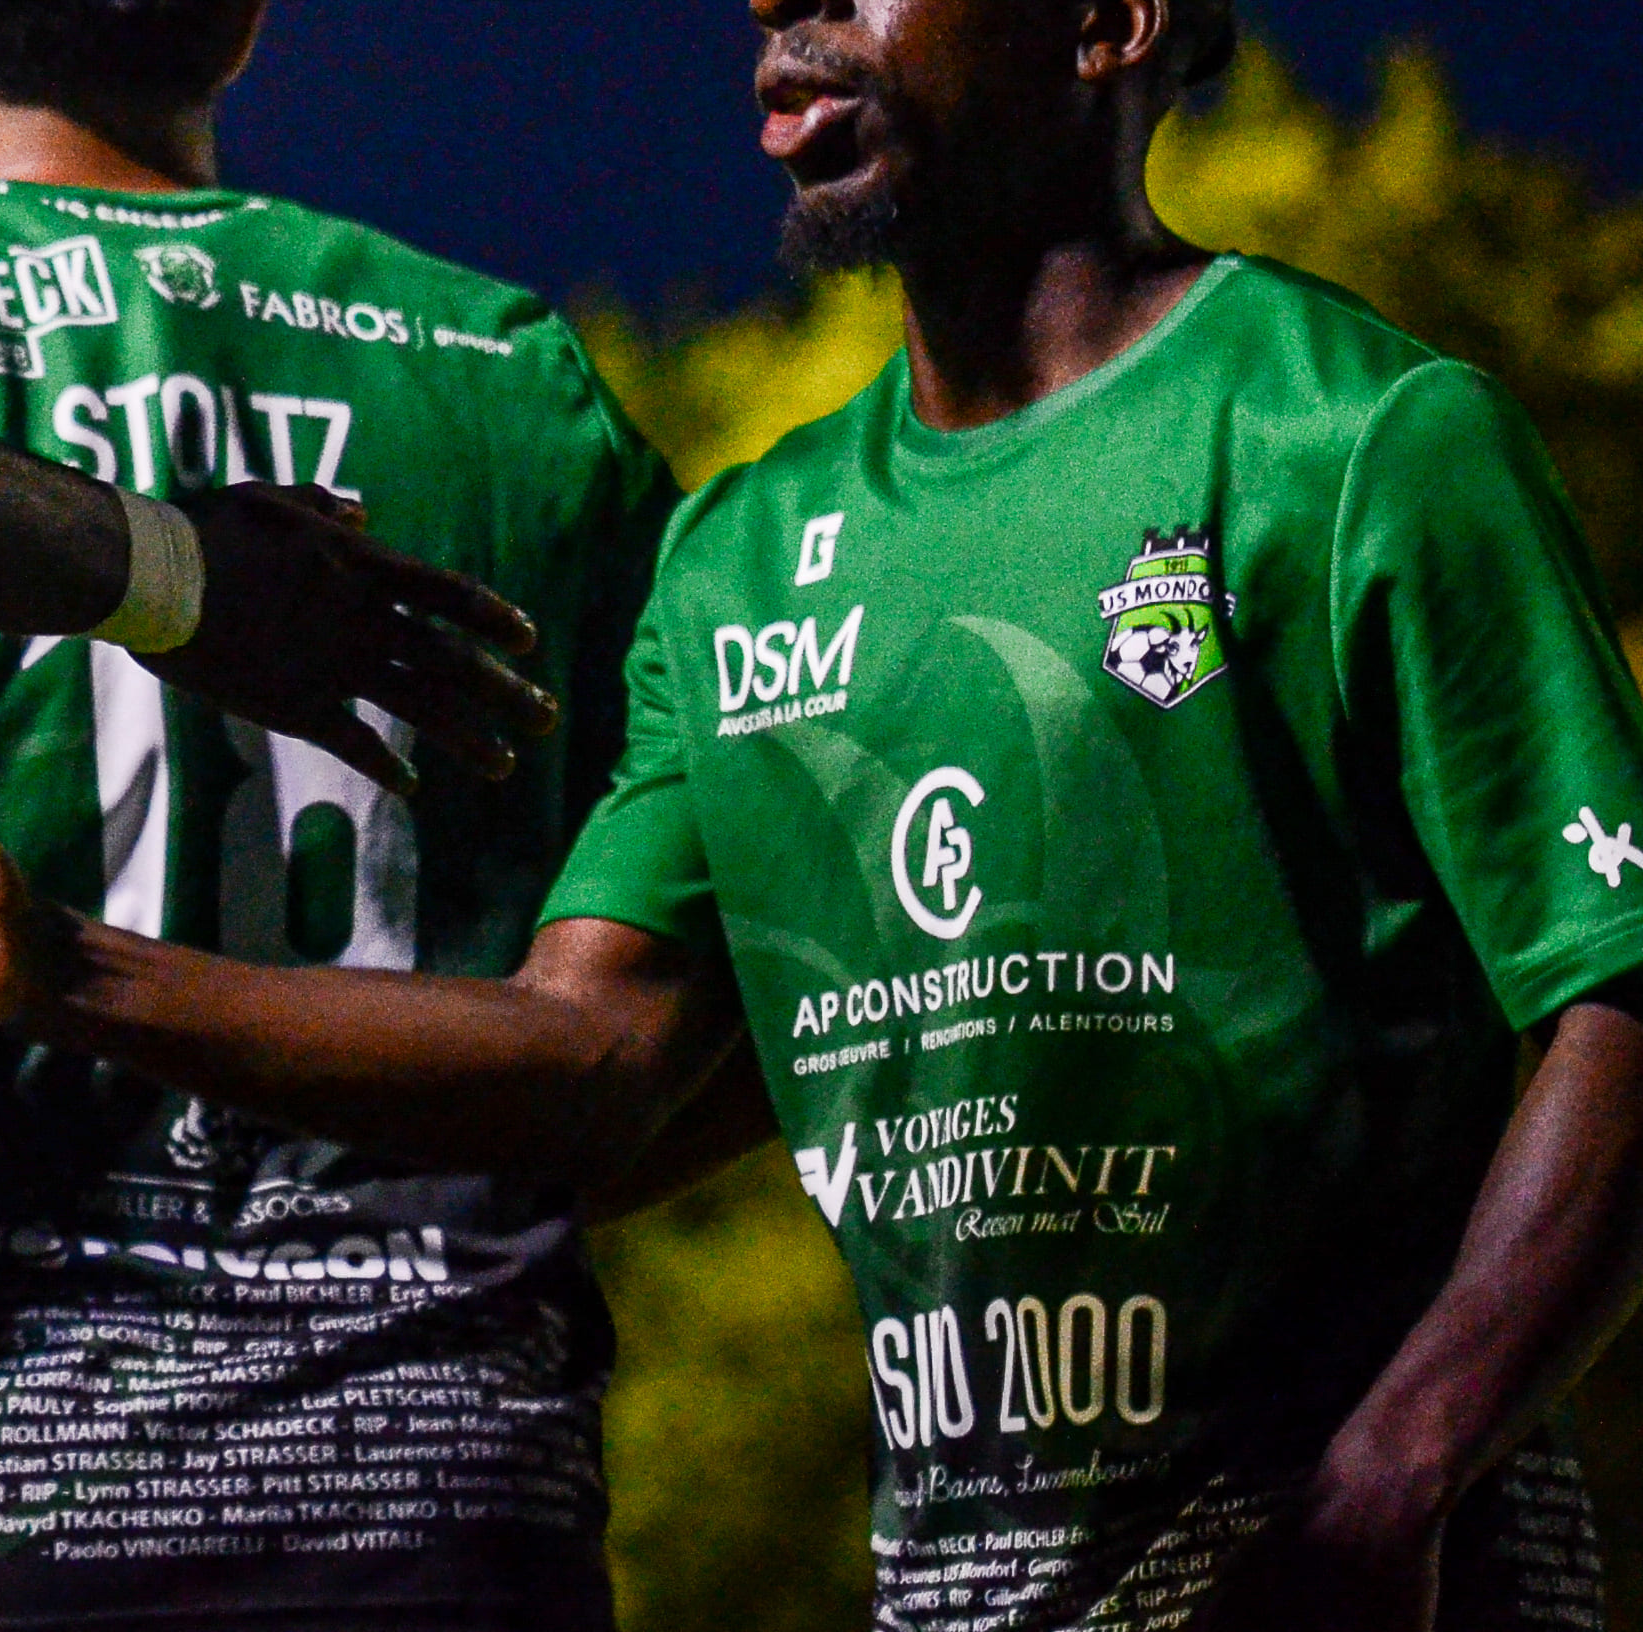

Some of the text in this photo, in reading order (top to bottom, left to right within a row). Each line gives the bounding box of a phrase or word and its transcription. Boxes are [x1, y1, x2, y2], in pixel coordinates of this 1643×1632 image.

[241, 282, 409, 345] FABROS
[52, 372, 363, 504] STOLTZ
[713, 604, 864, 713] DSM
[804, 689, 847, 718] COUR
[793, 951, 1175, 1038] AP CONSTRUCTION
[1030, 1013, 1175, 1034] ALENTOURS
[875, 1093, 1018, 1156] VOYAGES
[857, 1144, 1177, 1223] VANDIVINIT
[984, 1292, 1168, 1434] 2000
